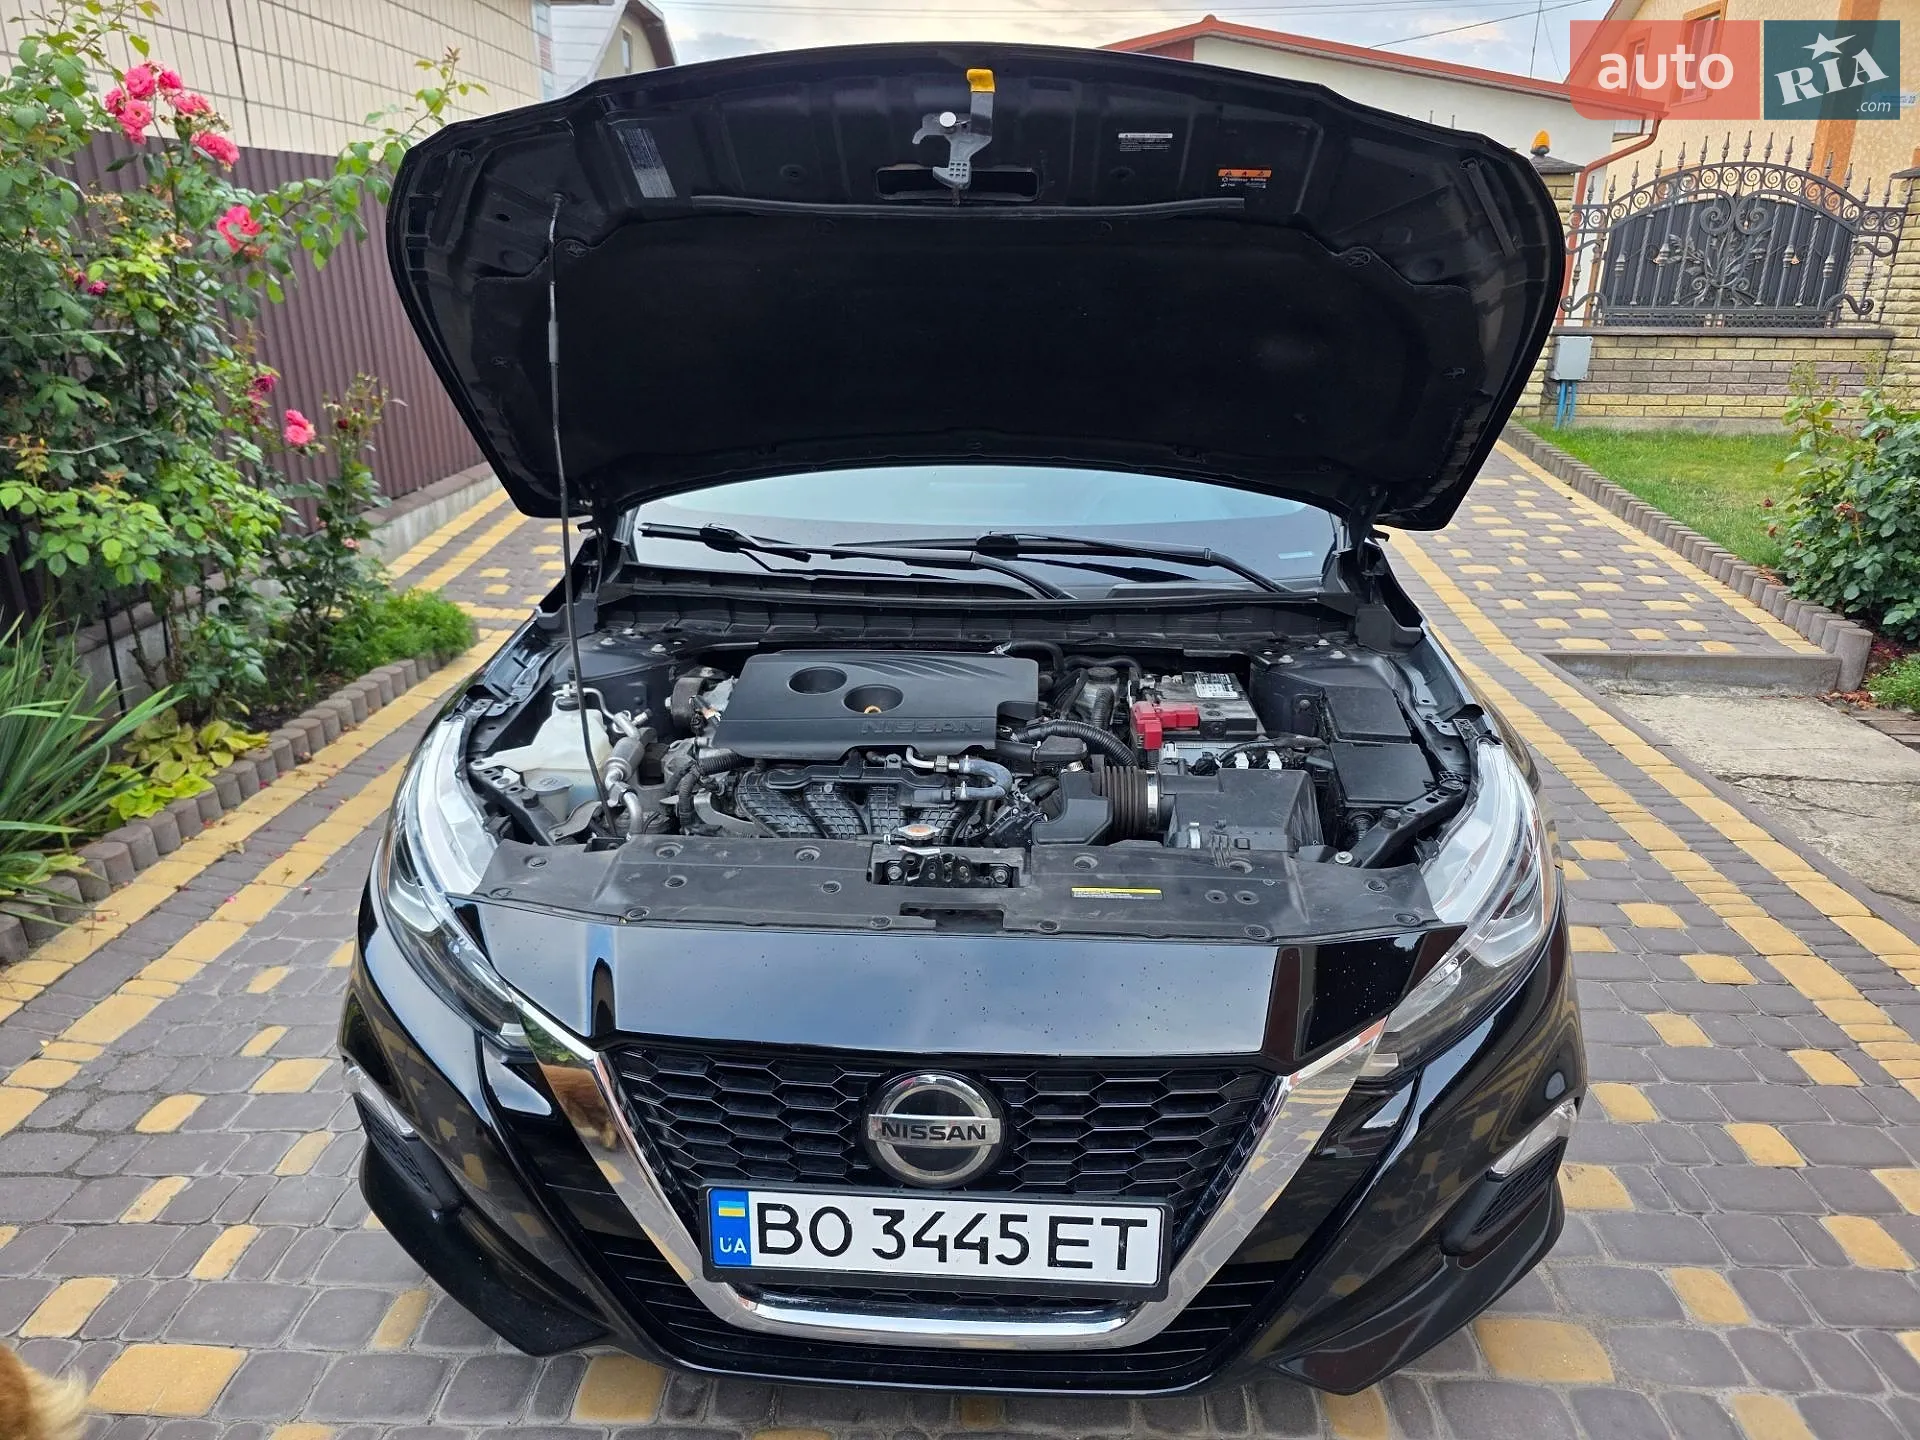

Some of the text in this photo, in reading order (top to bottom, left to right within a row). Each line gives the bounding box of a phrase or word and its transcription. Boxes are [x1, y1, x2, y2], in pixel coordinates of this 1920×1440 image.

[861, 719, 983, 733] NISSAN
[881, 1121, 986, 1141] NISSAN
[719, 1236, 747, 1254] UA
[757, 1202, 1148, 1271] BO 3445 ET
